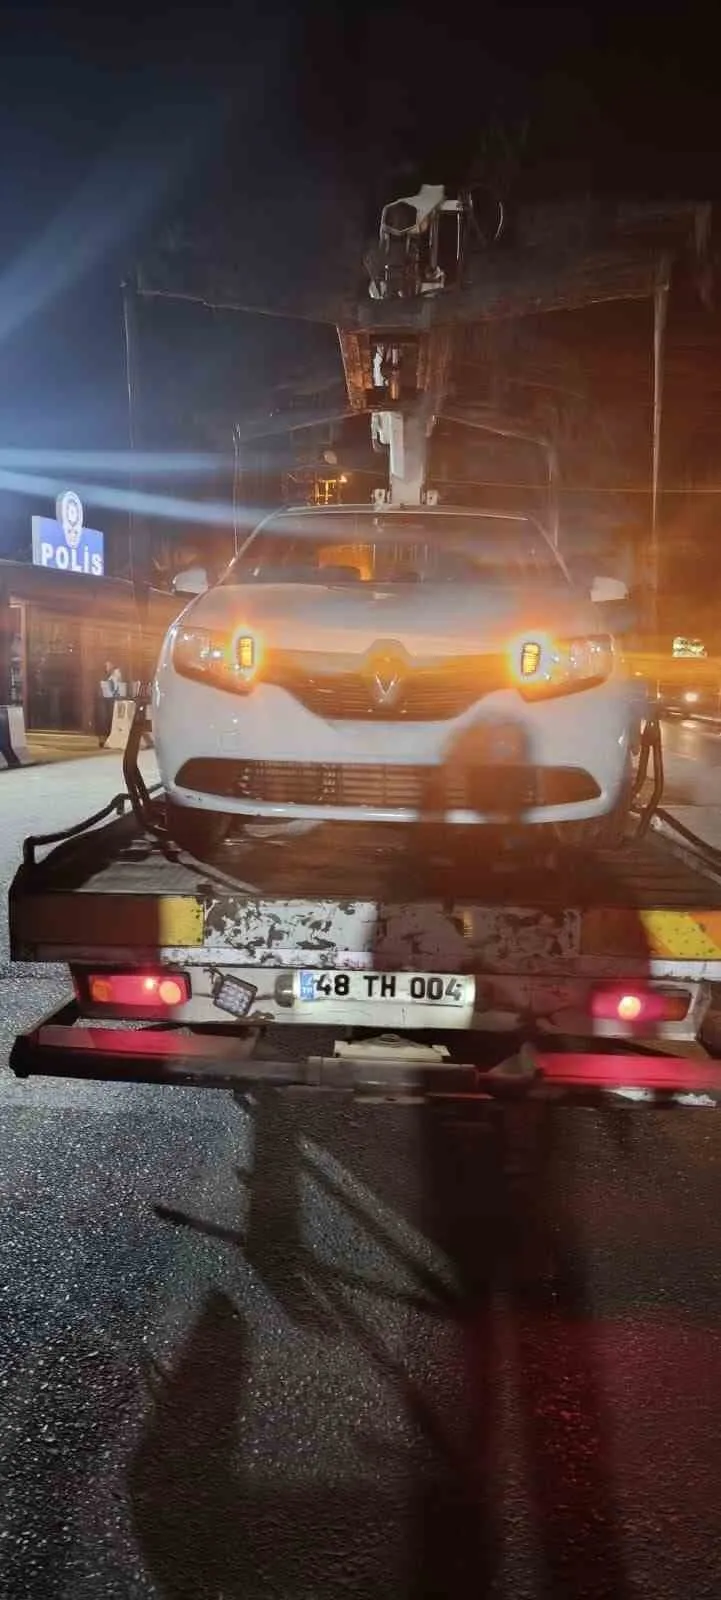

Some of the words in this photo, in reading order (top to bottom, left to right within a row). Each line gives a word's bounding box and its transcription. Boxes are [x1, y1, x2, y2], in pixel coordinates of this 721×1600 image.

[41, 542, 103, 576] POLİS
[316, 974, 350, 996] 48
[363, 975, 396, 997] TH
[410, 976, 462, 1001] 004
